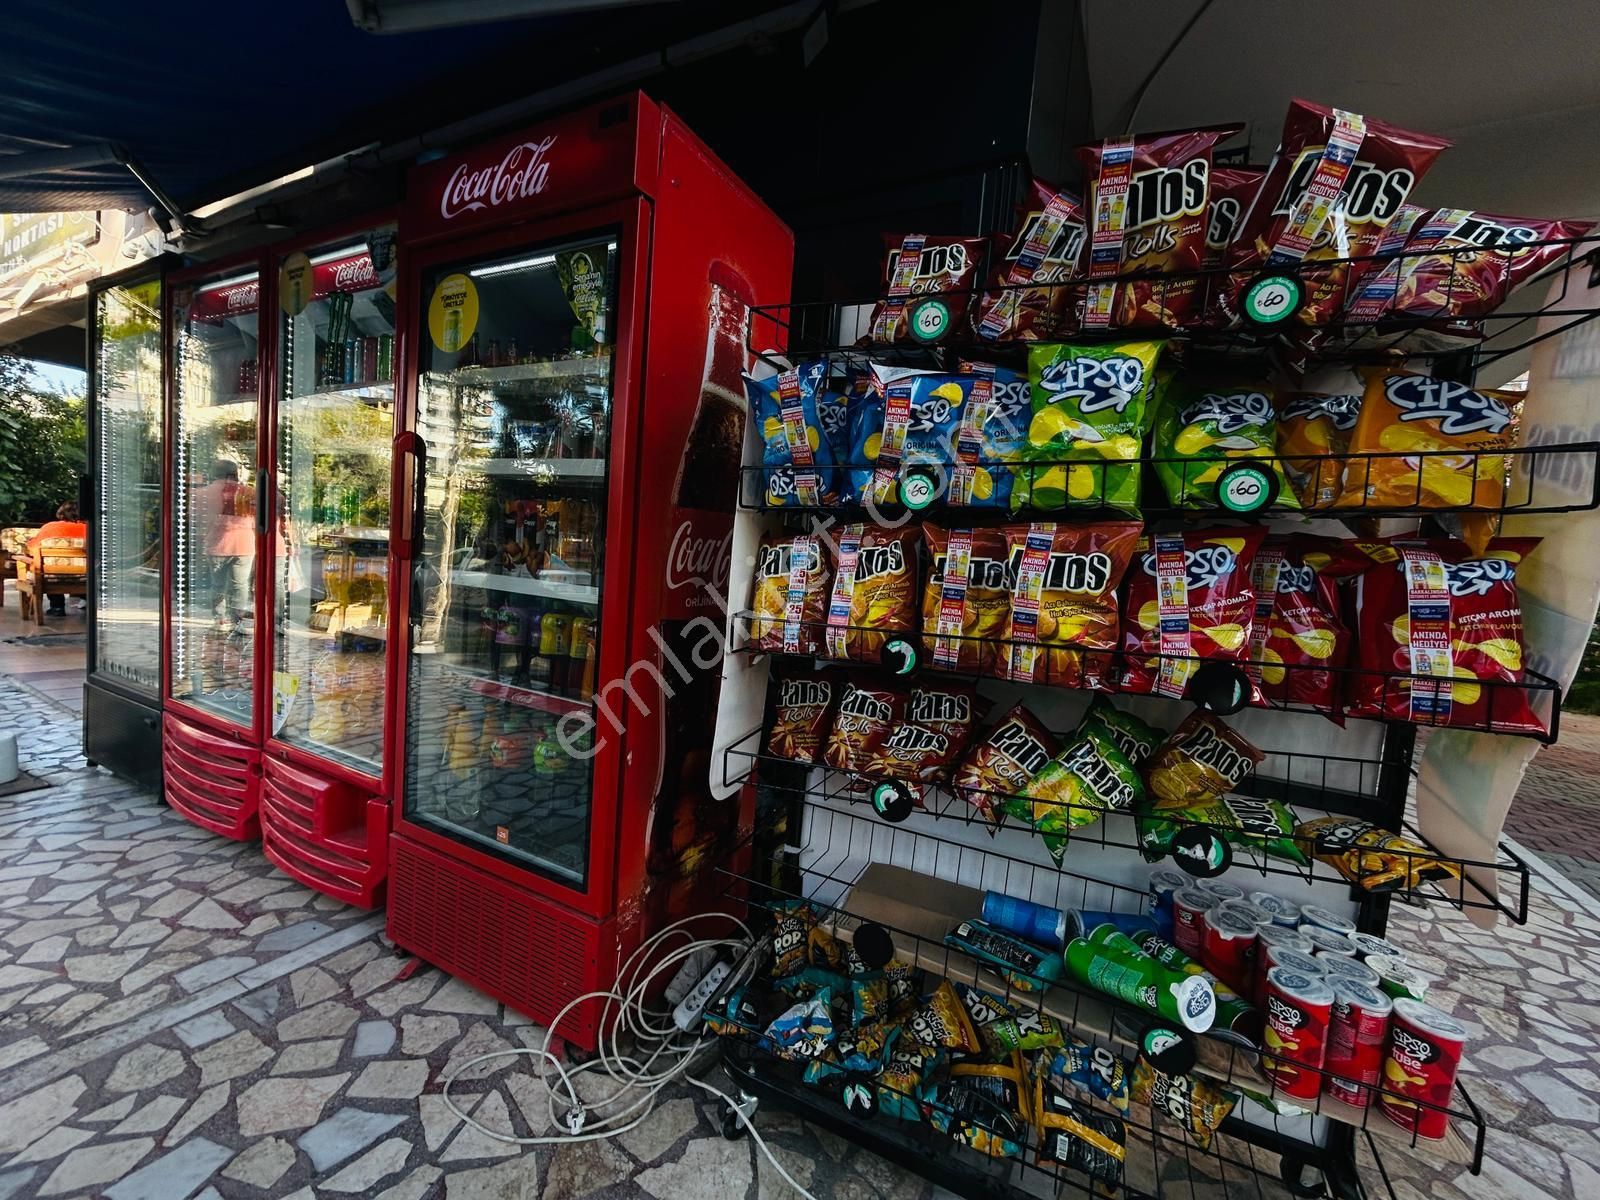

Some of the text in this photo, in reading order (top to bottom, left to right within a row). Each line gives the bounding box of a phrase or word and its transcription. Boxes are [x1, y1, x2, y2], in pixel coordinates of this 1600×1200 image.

[441, 136, 557, 219] Coca-Cola
[1101, 175, 1128, 186] ANINDA
[1315, 173, 1342, 188] ANINDA
[1099, 184, 1127, 196] HEDİYE!
[1309, 184, 1338, 199] HEDİYE!
[1450, 216, 1539, 257] TOS
[992, 381, 1031, 405] PSO
[887, 407, 909, 416] ANINDA
[666, 520, 734, 590] Coca-C
[1023, 556, 1046, 566] ANINDA
[1158, 561, 1184, 569] ANINDA
[793, 568, 807, 578] 25
[1021, 563, 1045, 573] HEDİYE!
[1159, 568, 1185, 577] HEDİYE!
[1217, 595, 1249, 608] AROMALI
[789, 604, 802, 614] 25
[941, 607, 962, 616] ANINDA
[1458, 612, 1487, 624] KETÇAP
[1013, 630, 1035, 639] ANINDA
[1412, 631, 1448, 640] ANINDA
[785, 641, 798, 653] 25
[1162, 641, 1189, 650] ANINDA
[1412, 640, 1448, 649] HEDİYE!
[836, 715, 873, 735] Rolls
[988, 719, 1050, 777] PaTO
[985, 751, 1028, 788] Rolls
